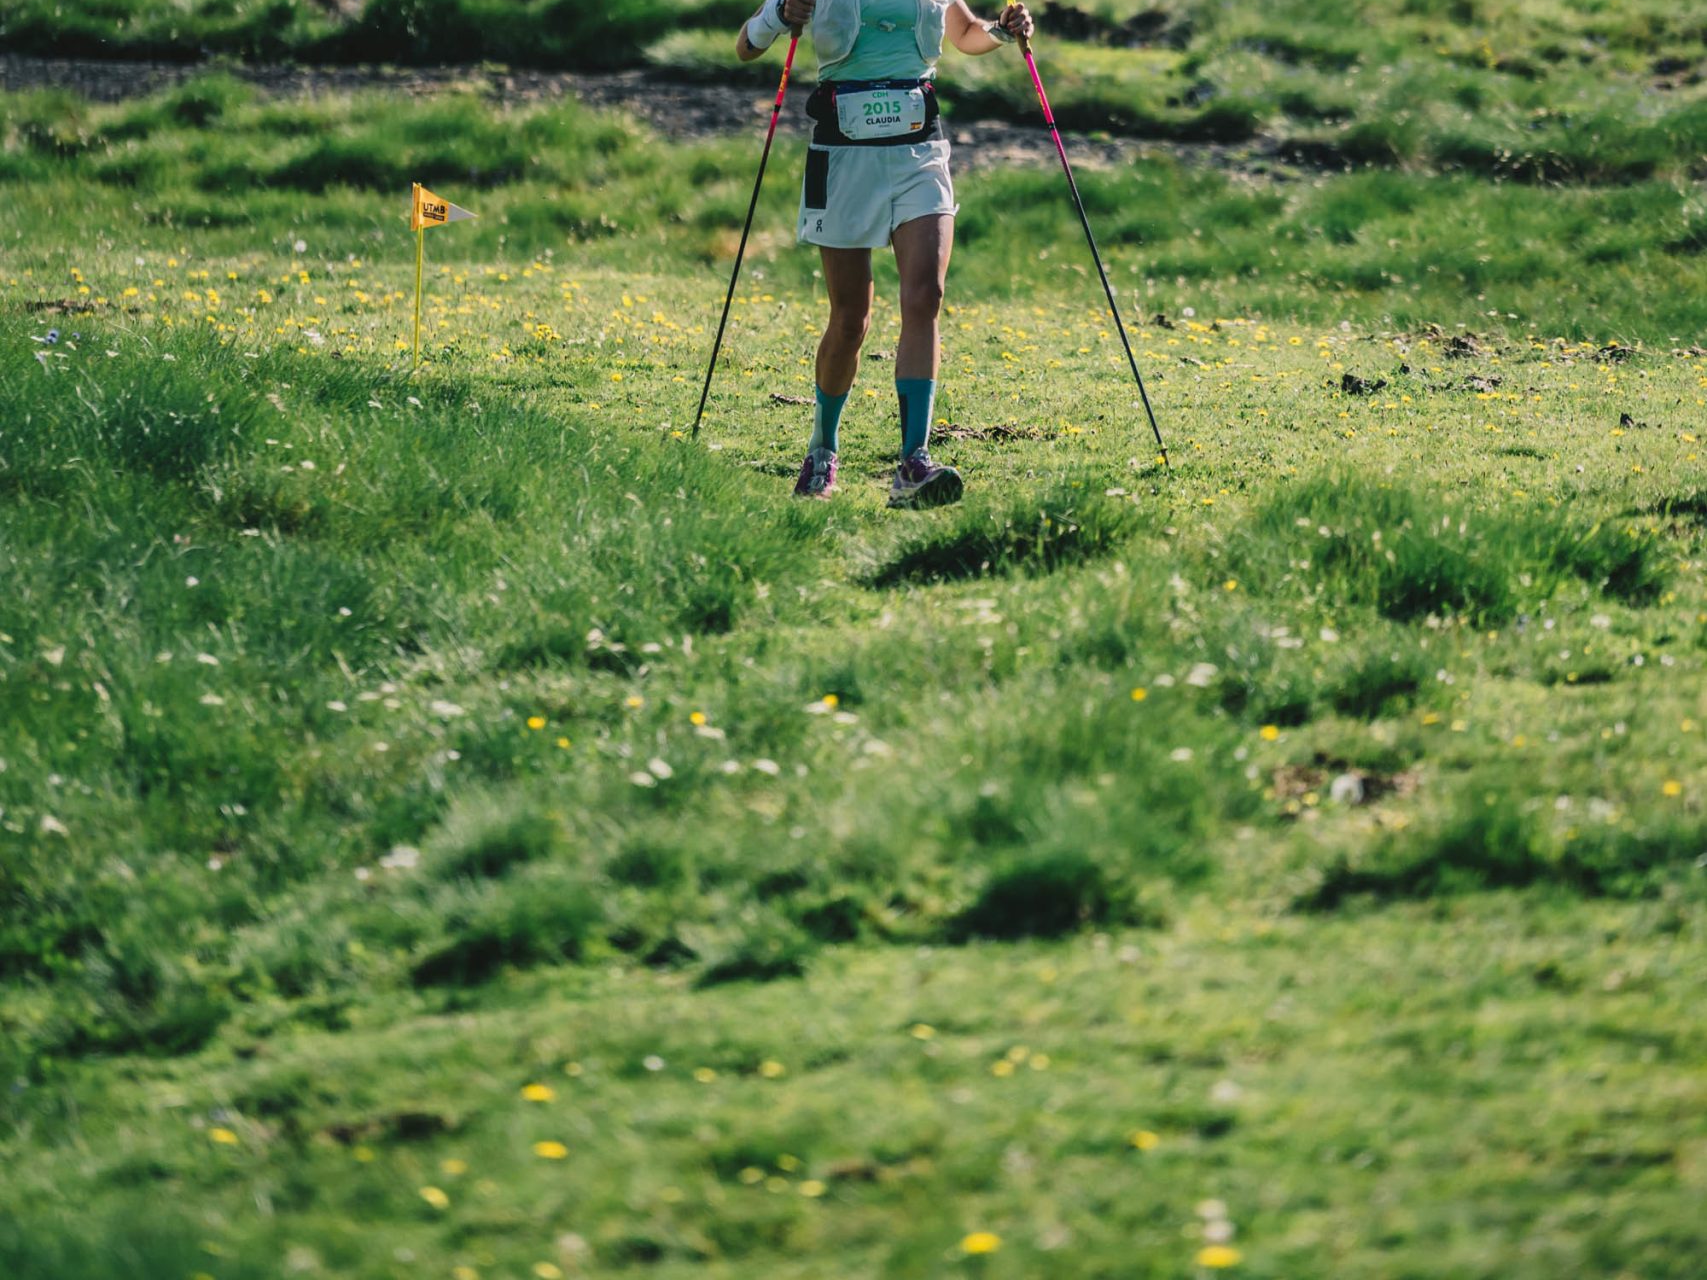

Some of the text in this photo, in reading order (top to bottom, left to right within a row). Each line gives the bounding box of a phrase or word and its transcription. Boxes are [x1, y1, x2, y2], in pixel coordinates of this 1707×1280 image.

[863, 101, 902, 116] 2015
[866, 116, 901, 125] CLAUDIA
[423, 203, 445, 214] UTMB
